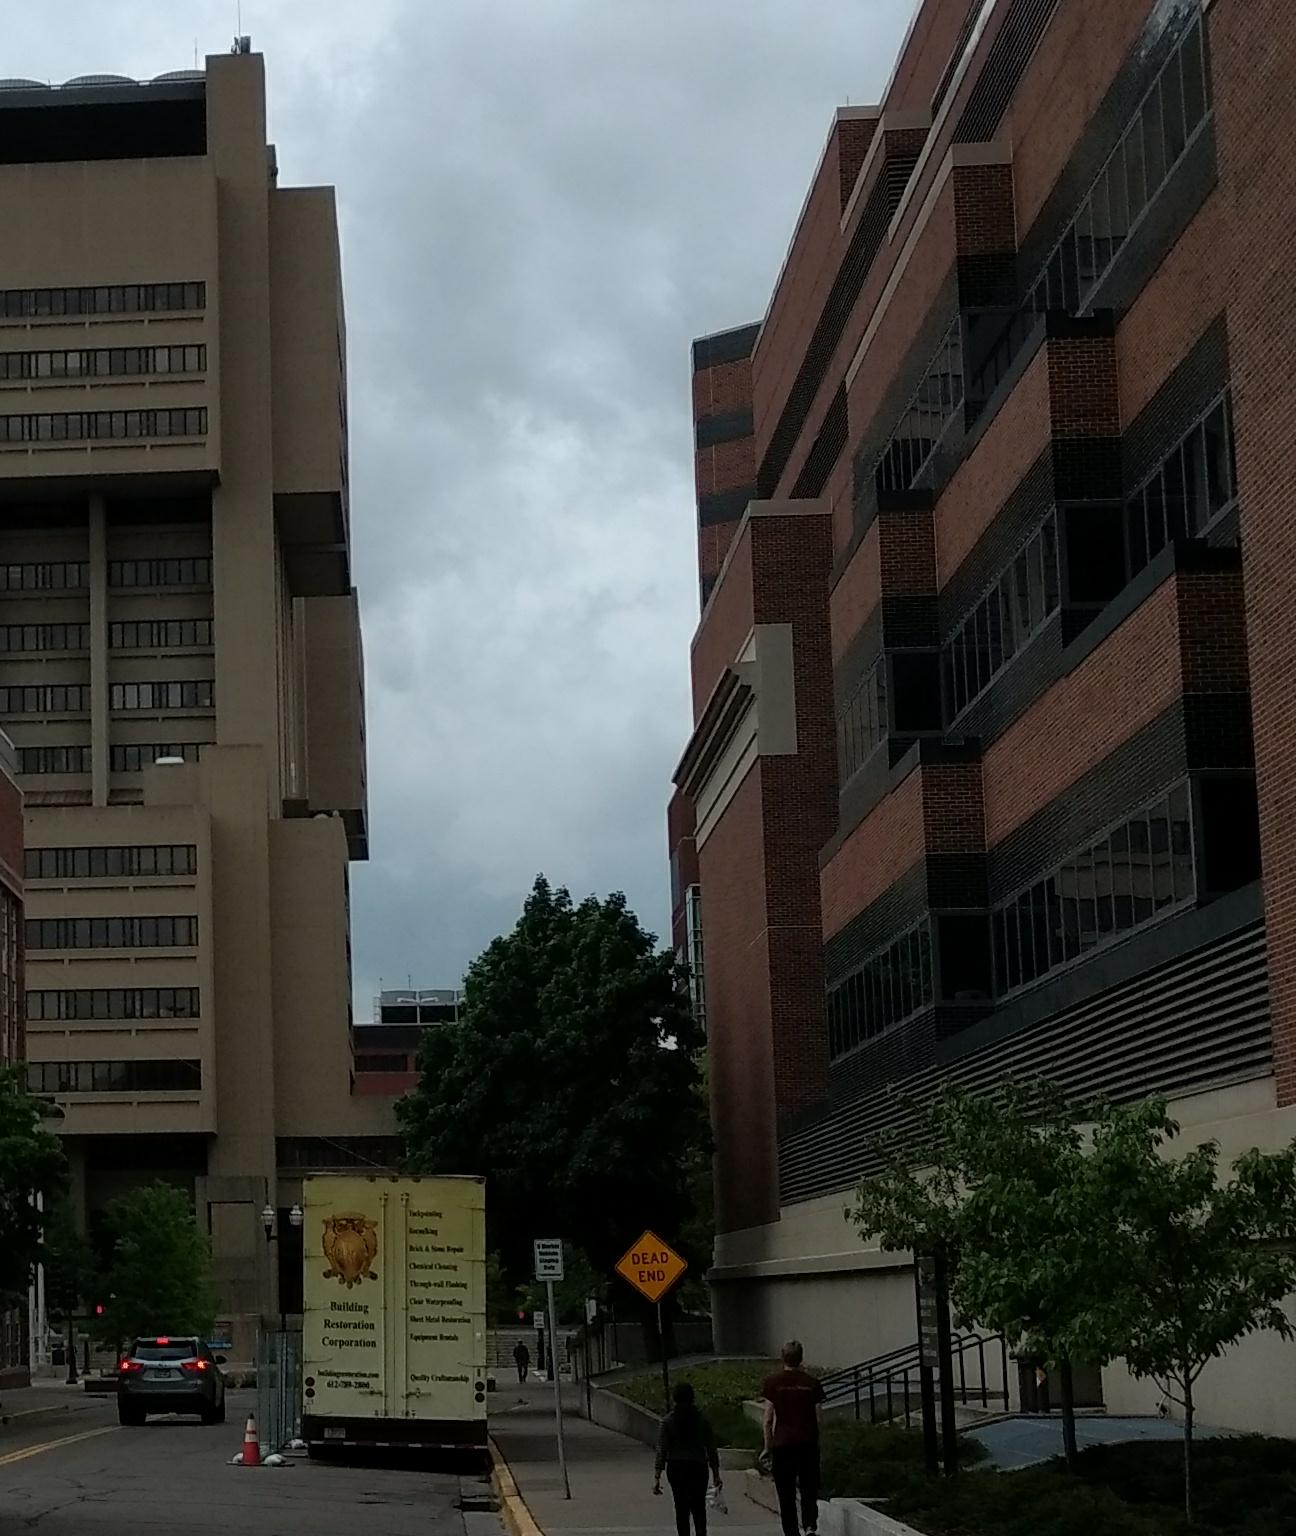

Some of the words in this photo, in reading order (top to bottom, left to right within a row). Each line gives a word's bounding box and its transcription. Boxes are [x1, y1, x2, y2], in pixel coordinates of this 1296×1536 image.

[631, 1252, 669, 1265] DEAD
[434, 1263, 458, 1272] Cleaning
[638, 1269, 666, 1283] END
[330, 1301, 369, 1314] Building
[425, 1298, 463, 1307] Waterproofing
[324, 1318, 375, 1330] Restoration
[425, 1315, 440, 1323] Metal
[321, 1336, 377, 1350] Corporation
[410, 1374, 430, 1383] Quality
[431, 1374, 470, 1384] Craftsmanship
